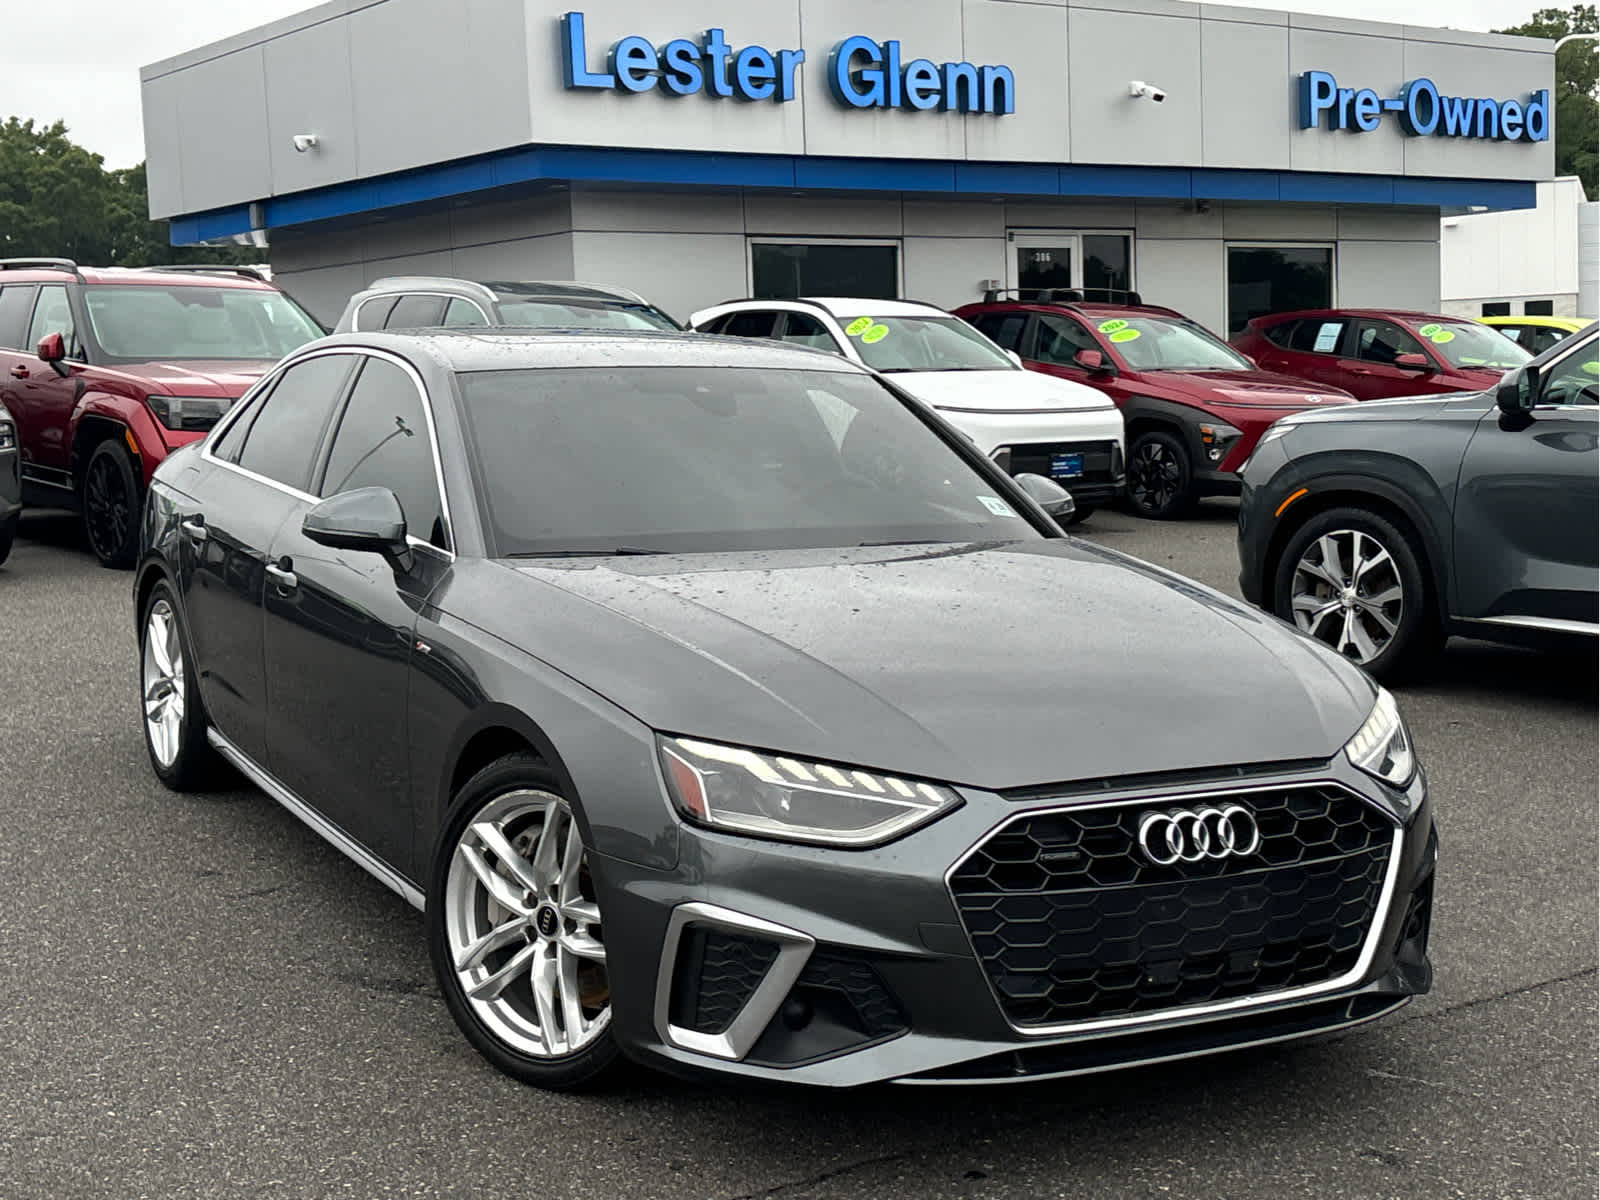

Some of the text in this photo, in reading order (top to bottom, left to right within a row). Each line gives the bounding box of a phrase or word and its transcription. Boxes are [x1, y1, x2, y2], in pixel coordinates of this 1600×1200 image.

[561, 11, 1016, 115] Lester Glenn
[1300, 70, 1550, 143] Pre-Owned
